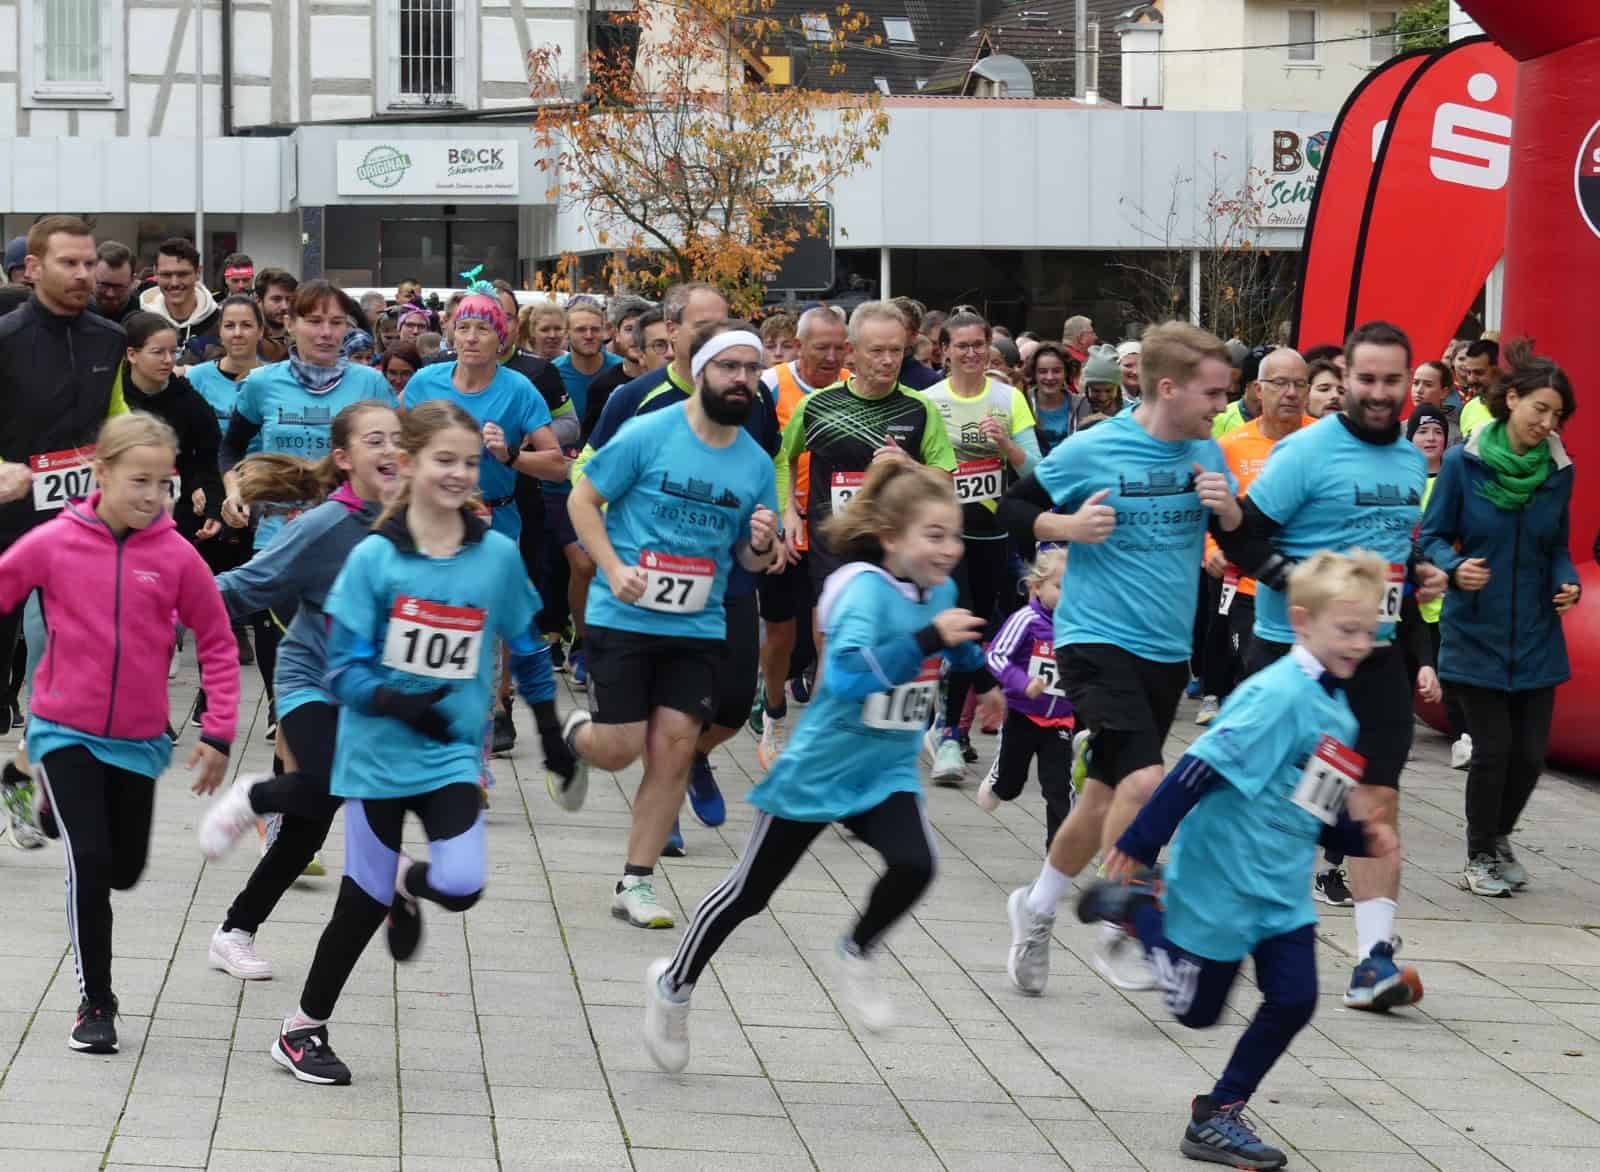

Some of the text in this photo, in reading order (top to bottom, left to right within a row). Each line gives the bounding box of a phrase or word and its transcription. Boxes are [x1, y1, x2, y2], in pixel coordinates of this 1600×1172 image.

[357, 154, 411, 180] ORIGINAL
[44, 467, 93, 502] 207
[956, 474, 998, 500] 520
[655, 576, 695, 606] 27
[402, 628, 473, 671] 104
